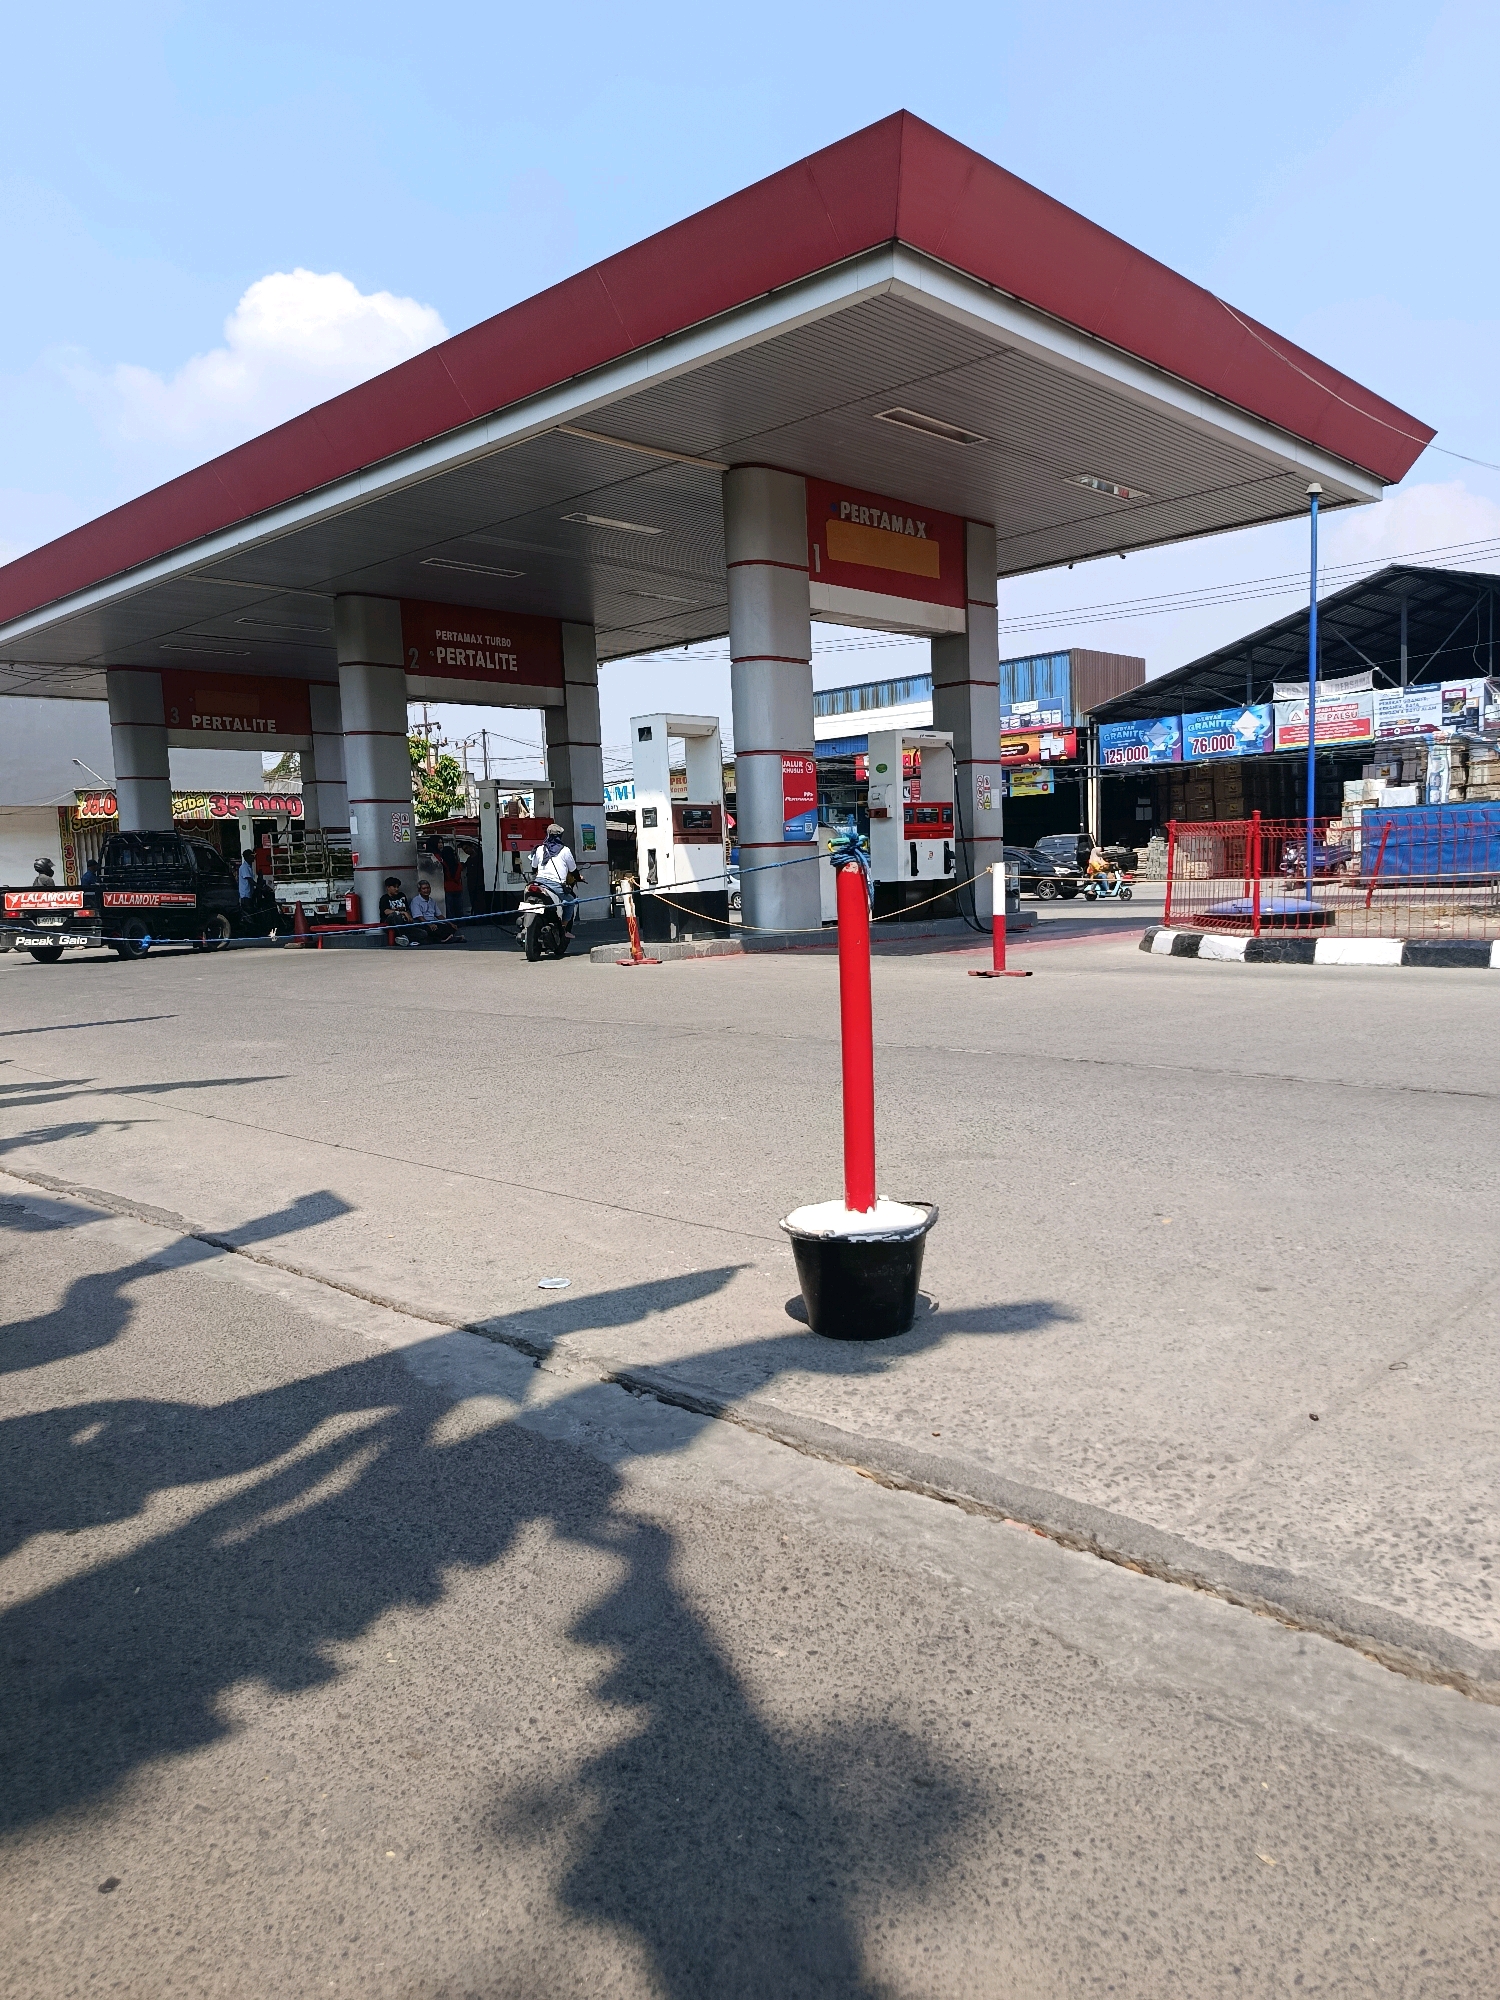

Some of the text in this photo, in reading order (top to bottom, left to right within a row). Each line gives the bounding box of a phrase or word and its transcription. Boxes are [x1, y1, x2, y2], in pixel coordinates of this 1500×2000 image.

[840, 501, 926, 538] PERTAMAX
[813, 543, 820, 573] 1
[435, 629, 512, 648] PERTAMAX TURBO
[408, 647, 420, 669] 2
[436, 646, 518, 672] PERTALITE
[170, 706, 180, 724] 3
[191, 714, 277, 733] PERTALITE
[1326, 711, 1358, 721] PALSU
[1187, 719, 1233, 732] GRANITE
[1103, 730, 1145, 742] GRANITE
[1191, 734, 1235, 754] 76.000
[20, 892, 80, 903] LALAMOVE
[112, 893, 160, 905] LALAMOVE
[15, 936, 54, 946] Pacak
